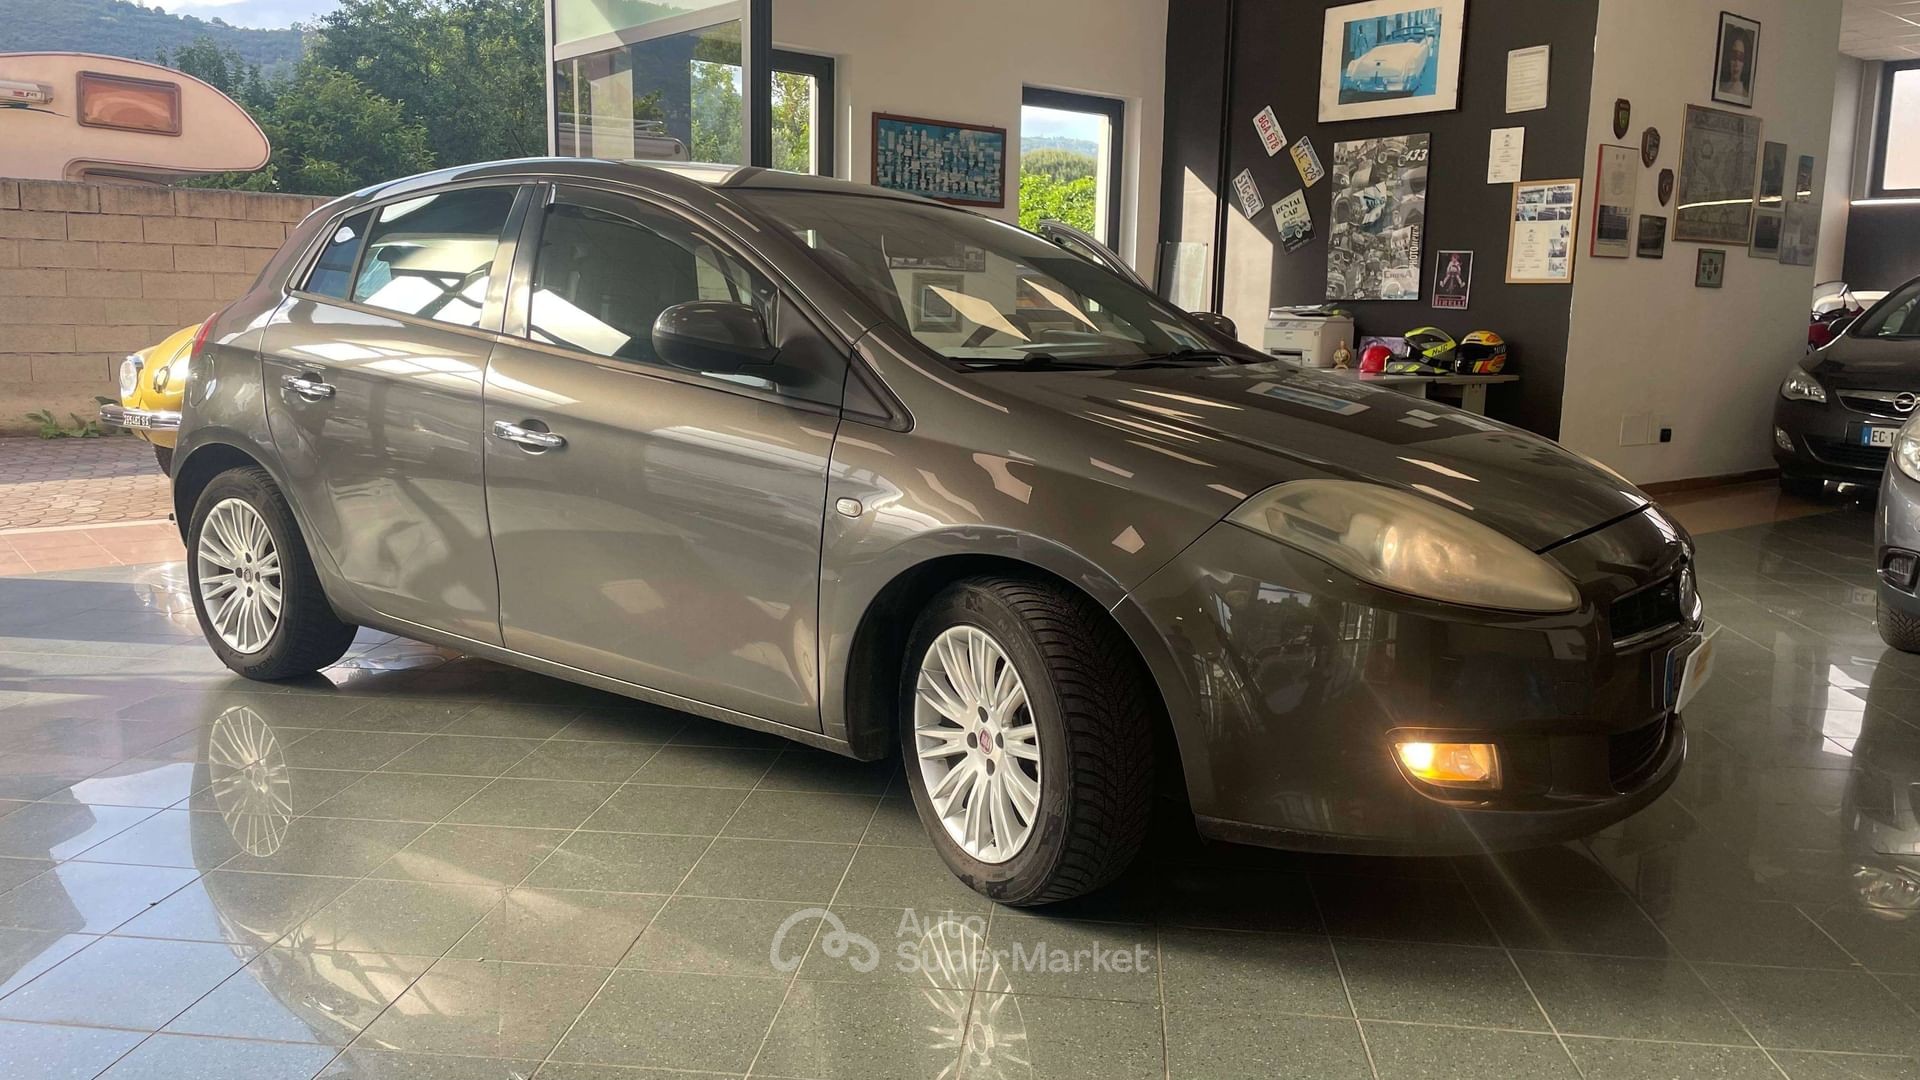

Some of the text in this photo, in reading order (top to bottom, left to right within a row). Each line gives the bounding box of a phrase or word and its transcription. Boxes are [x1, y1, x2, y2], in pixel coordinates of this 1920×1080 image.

[1258, 114, 1280, 150] BGA 678
[1275, 198, 1302, 215] RENTAL
[1283, 206, 1299, 219] CAR
[1435, 294, 1465, 307] PIRELLI
[1872, 431, 1885, 443] EC
